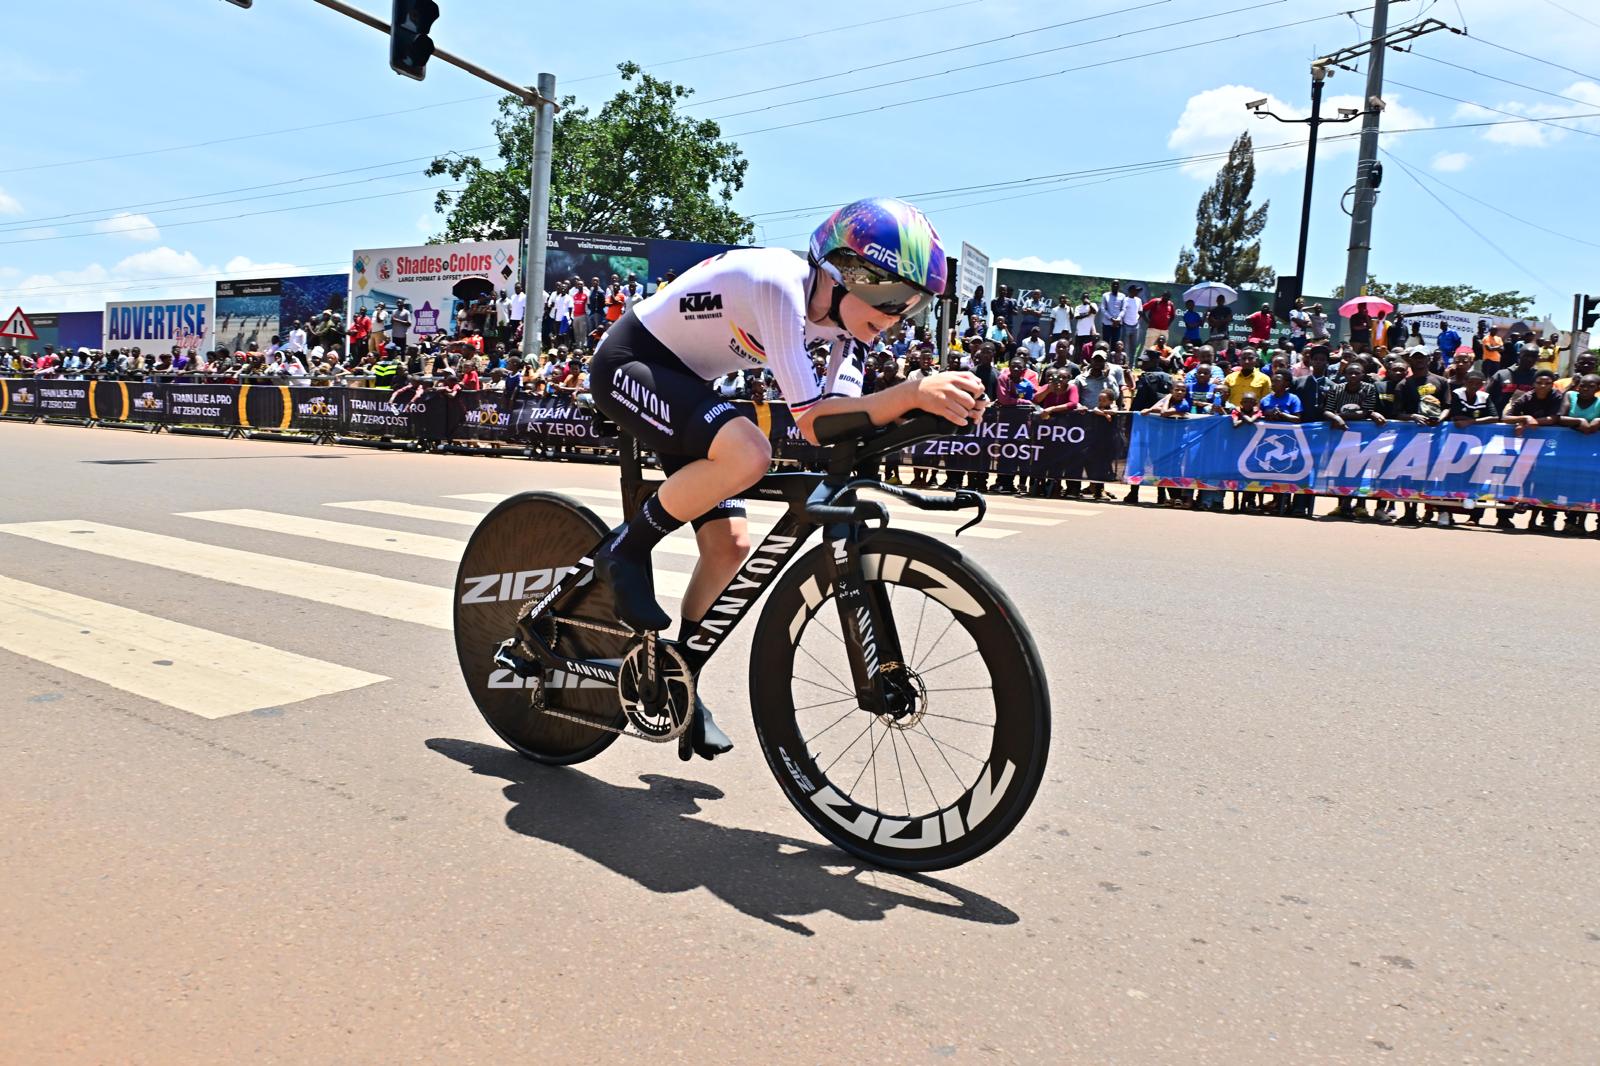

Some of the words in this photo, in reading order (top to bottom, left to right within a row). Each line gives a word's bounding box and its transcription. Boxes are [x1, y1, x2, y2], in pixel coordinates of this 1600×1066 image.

[577, 242, 632, 252] visitrwanda.com
[863, 242, 916, 274] GIRO
[396, 255, 443, 275] Shades
[449, 252, 492, 272] Colors
[679, 291, 723, 313] KTM
[108, 303, 206, 341] ADVERTISE
[172, 393, 193, 403] TRAIN
[194, 394, 210, 404] LIKE
[210, 395, 217, 404] A
[217, 395, 232, 405] PRO
[350, 399, 377, 411] TRAIN
[610, 390, 639, 413] SRAM
[612, 368, 671, 423] CANYON
[172, 406, 181, 415] AT
[182, 407, 201, 415] ZERO
[202, 408, 221, 416] COST
[298, 403, 338, 416] WHOOSH
[350, 413, 361, 423] AT
[362, 414, 385, 425] ZERO
[386, 416, 408, 426] COST
[465, 410, 511, 426] WHOOSH
[530, 407, 571, 419] TRAIN
[527, 422, 543, 434] AT
[545, 422, 586, 438] ZERO
[963, 422, 1010, 439] IKE
[1013, 423, 1030, 440] A
[1037, 425, 1085, 444] PRO
[923, 440, 981, 456] ZERO
[987, 443, 1044, 461] COST
[1317, 430, 1545, 486] MAPEI
[531, 584, 562, 619] SRAM
[686, 534, 798, 652] CANYON
[856, 606, 880, 680] NYON
[566, 660, 616, 682] CANYON
